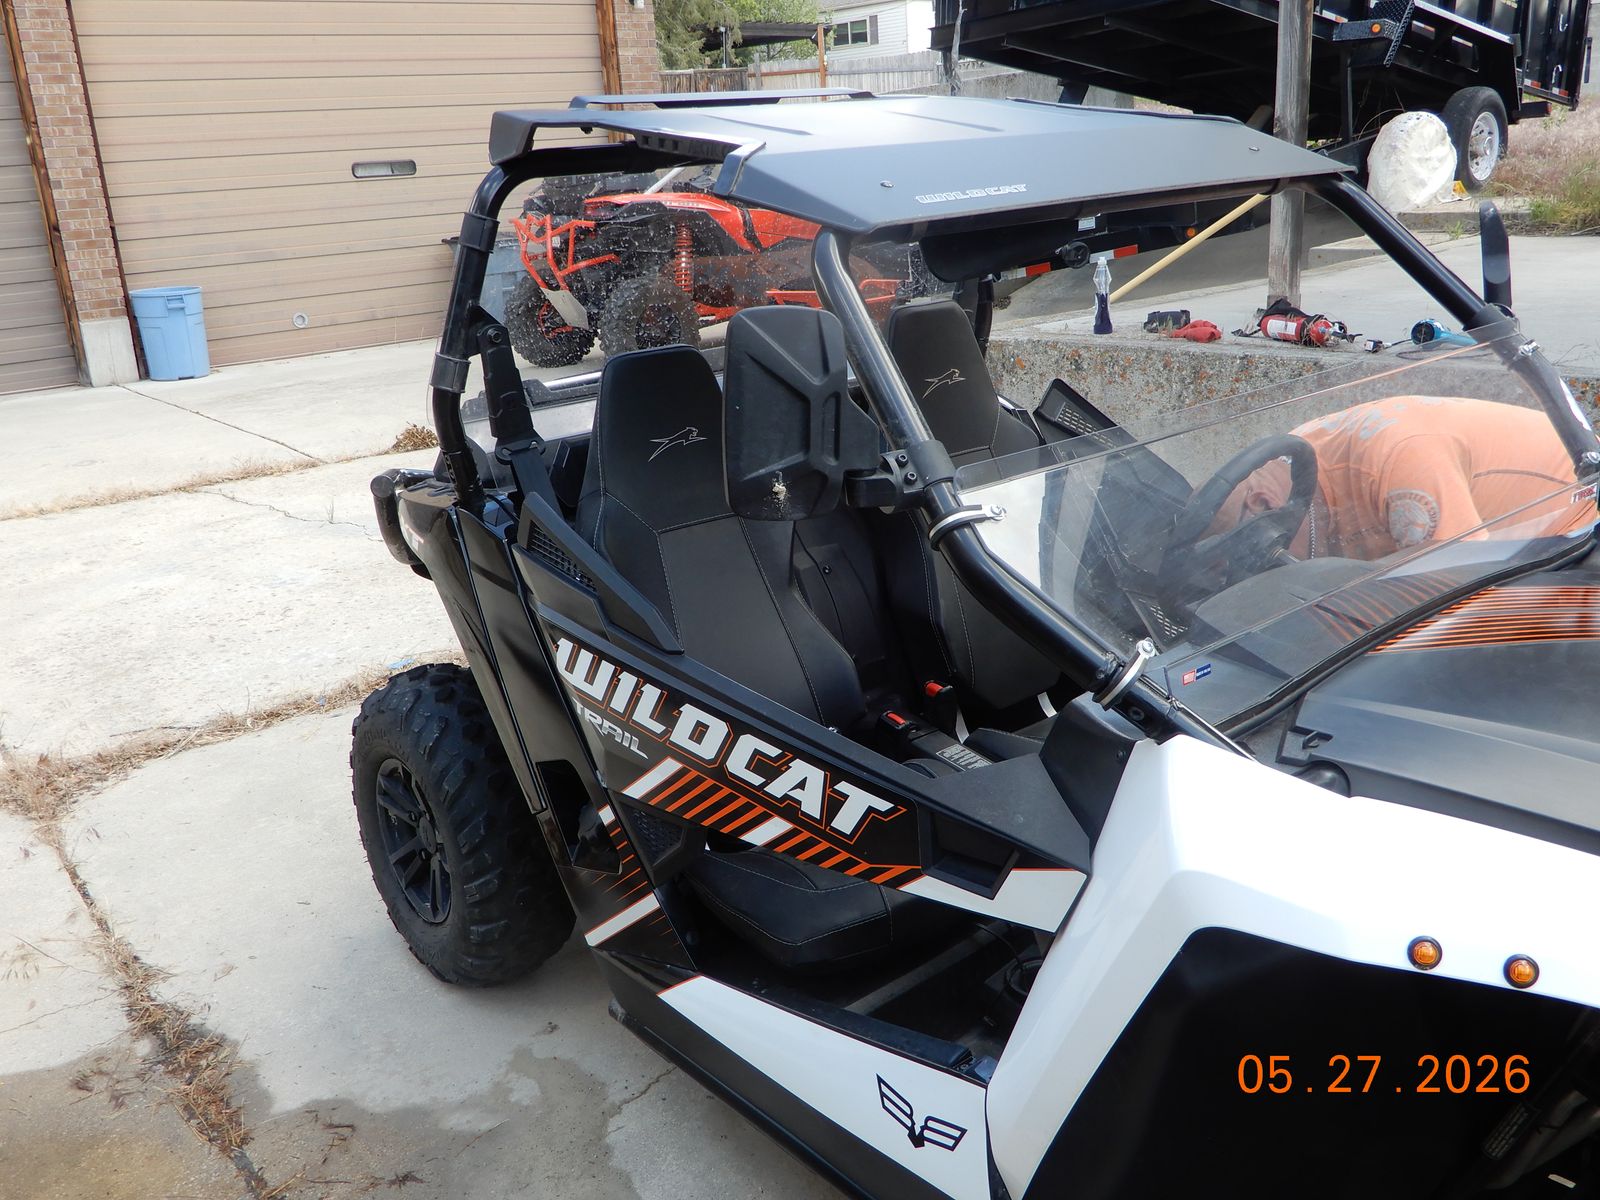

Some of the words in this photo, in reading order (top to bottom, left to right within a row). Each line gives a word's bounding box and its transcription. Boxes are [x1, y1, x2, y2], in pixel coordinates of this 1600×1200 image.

[915, 183, 1027, 204] WILDCAT
[554, 637, 897, 836] WILDCAT
[572, 697, 649, 759] TRAIL
